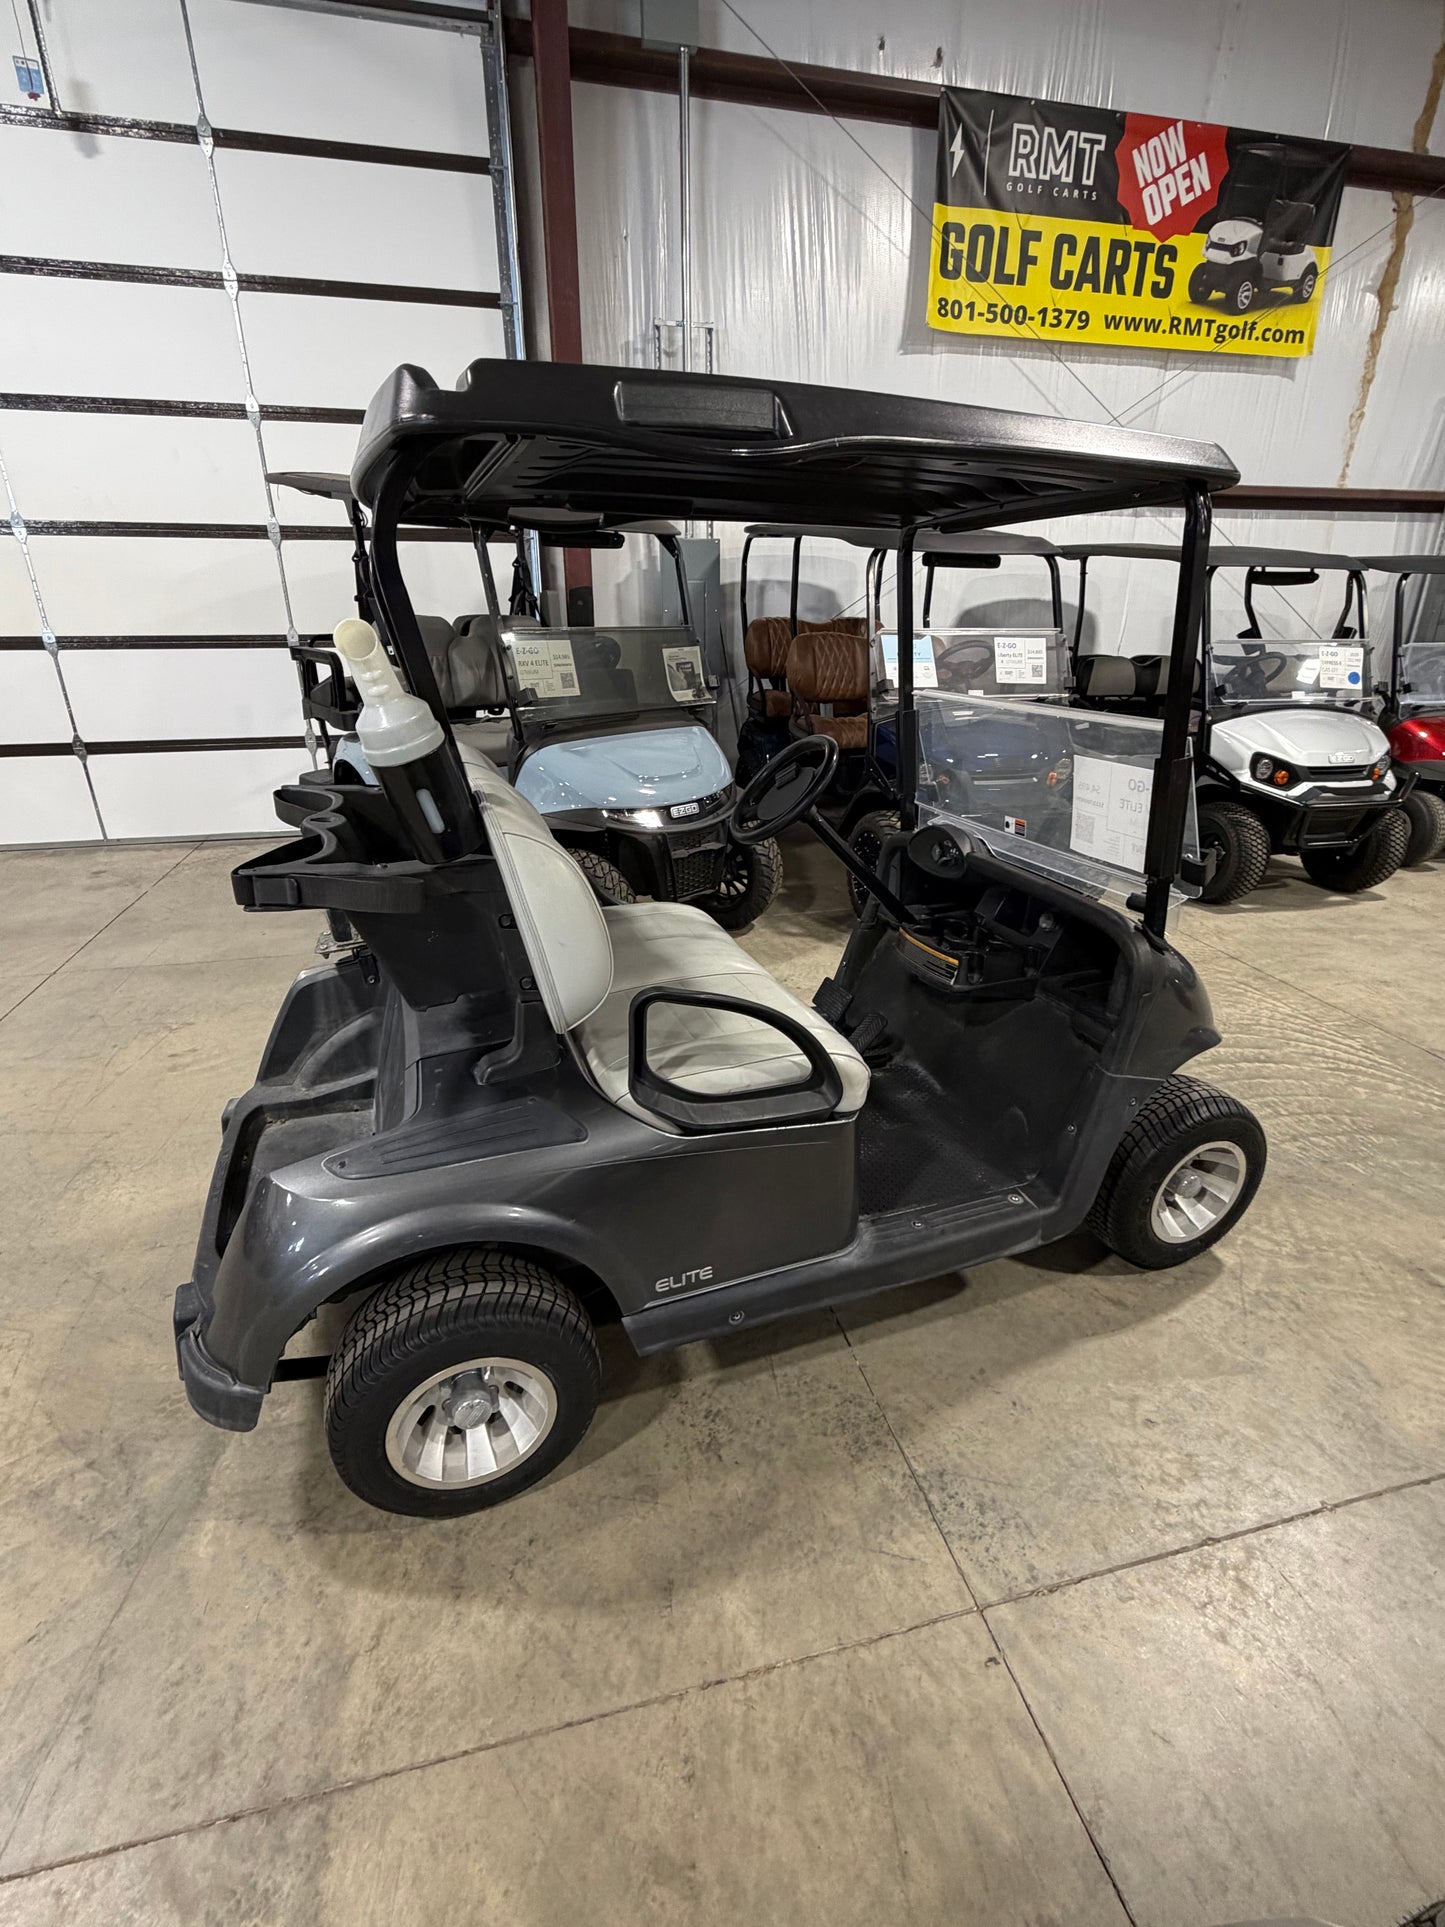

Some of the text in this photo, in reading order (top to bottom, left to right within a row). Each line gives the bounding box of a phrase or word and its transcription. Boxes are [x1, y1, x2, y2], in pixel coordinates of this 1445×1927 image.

[1008, 122, 1107, 186] RMT
[1131, 120, 1187, 189] NOW
[1006, 181, 1097, 201] GOLF CARTS
[1142, 151, 1212, 226] OPEN
[938, 221, 1178, 299] GOLF CARTS
[937, 297, 1305, 344] 801-500-1379 www.RMTgolf.com
[516, 647, 540, 655] E-Z-GO
[655, 1266, 713, 1292] ELITE
